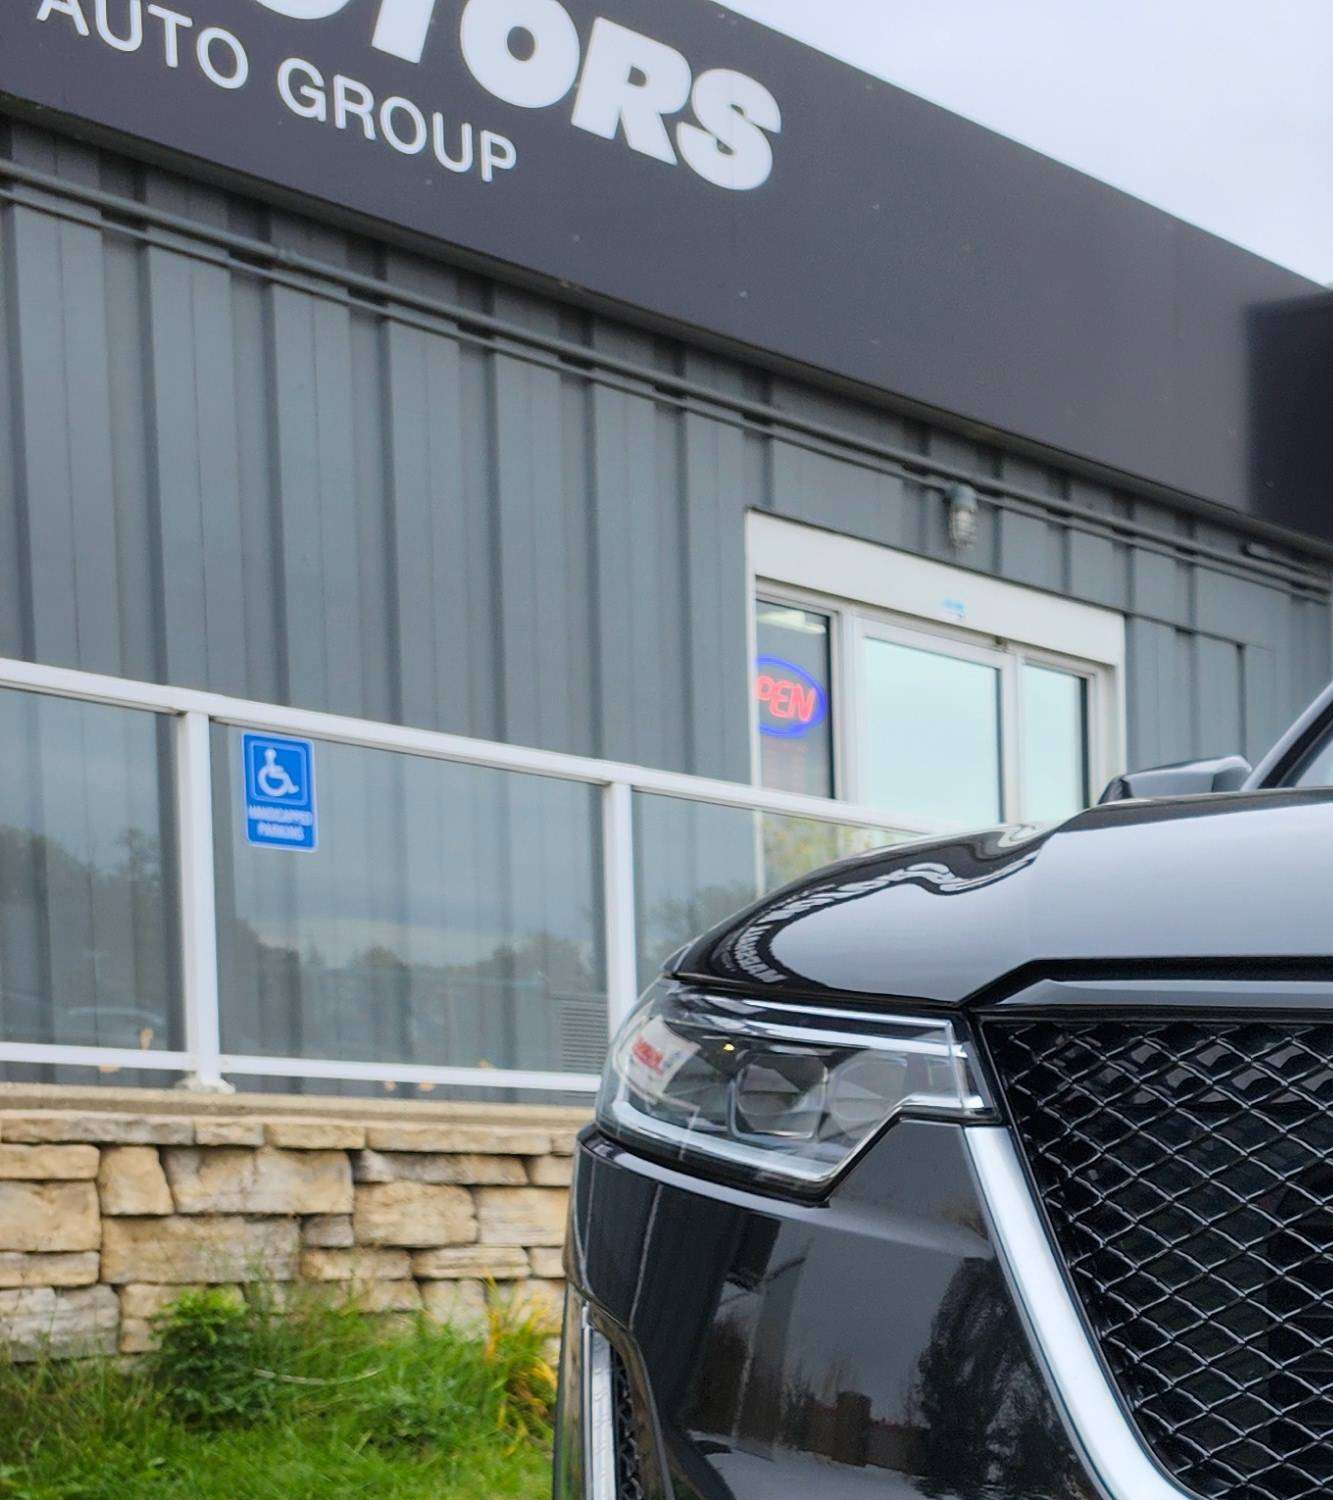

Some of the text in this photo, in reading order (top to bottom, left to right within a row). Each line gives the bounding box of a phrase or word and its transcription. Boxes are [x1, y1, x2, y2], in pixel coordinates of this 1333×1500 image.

[36, 0, 517, 182] AUTO GROUP
[252, 0, 782, 190] ORS
[754, 675, 816, 722] PEN
